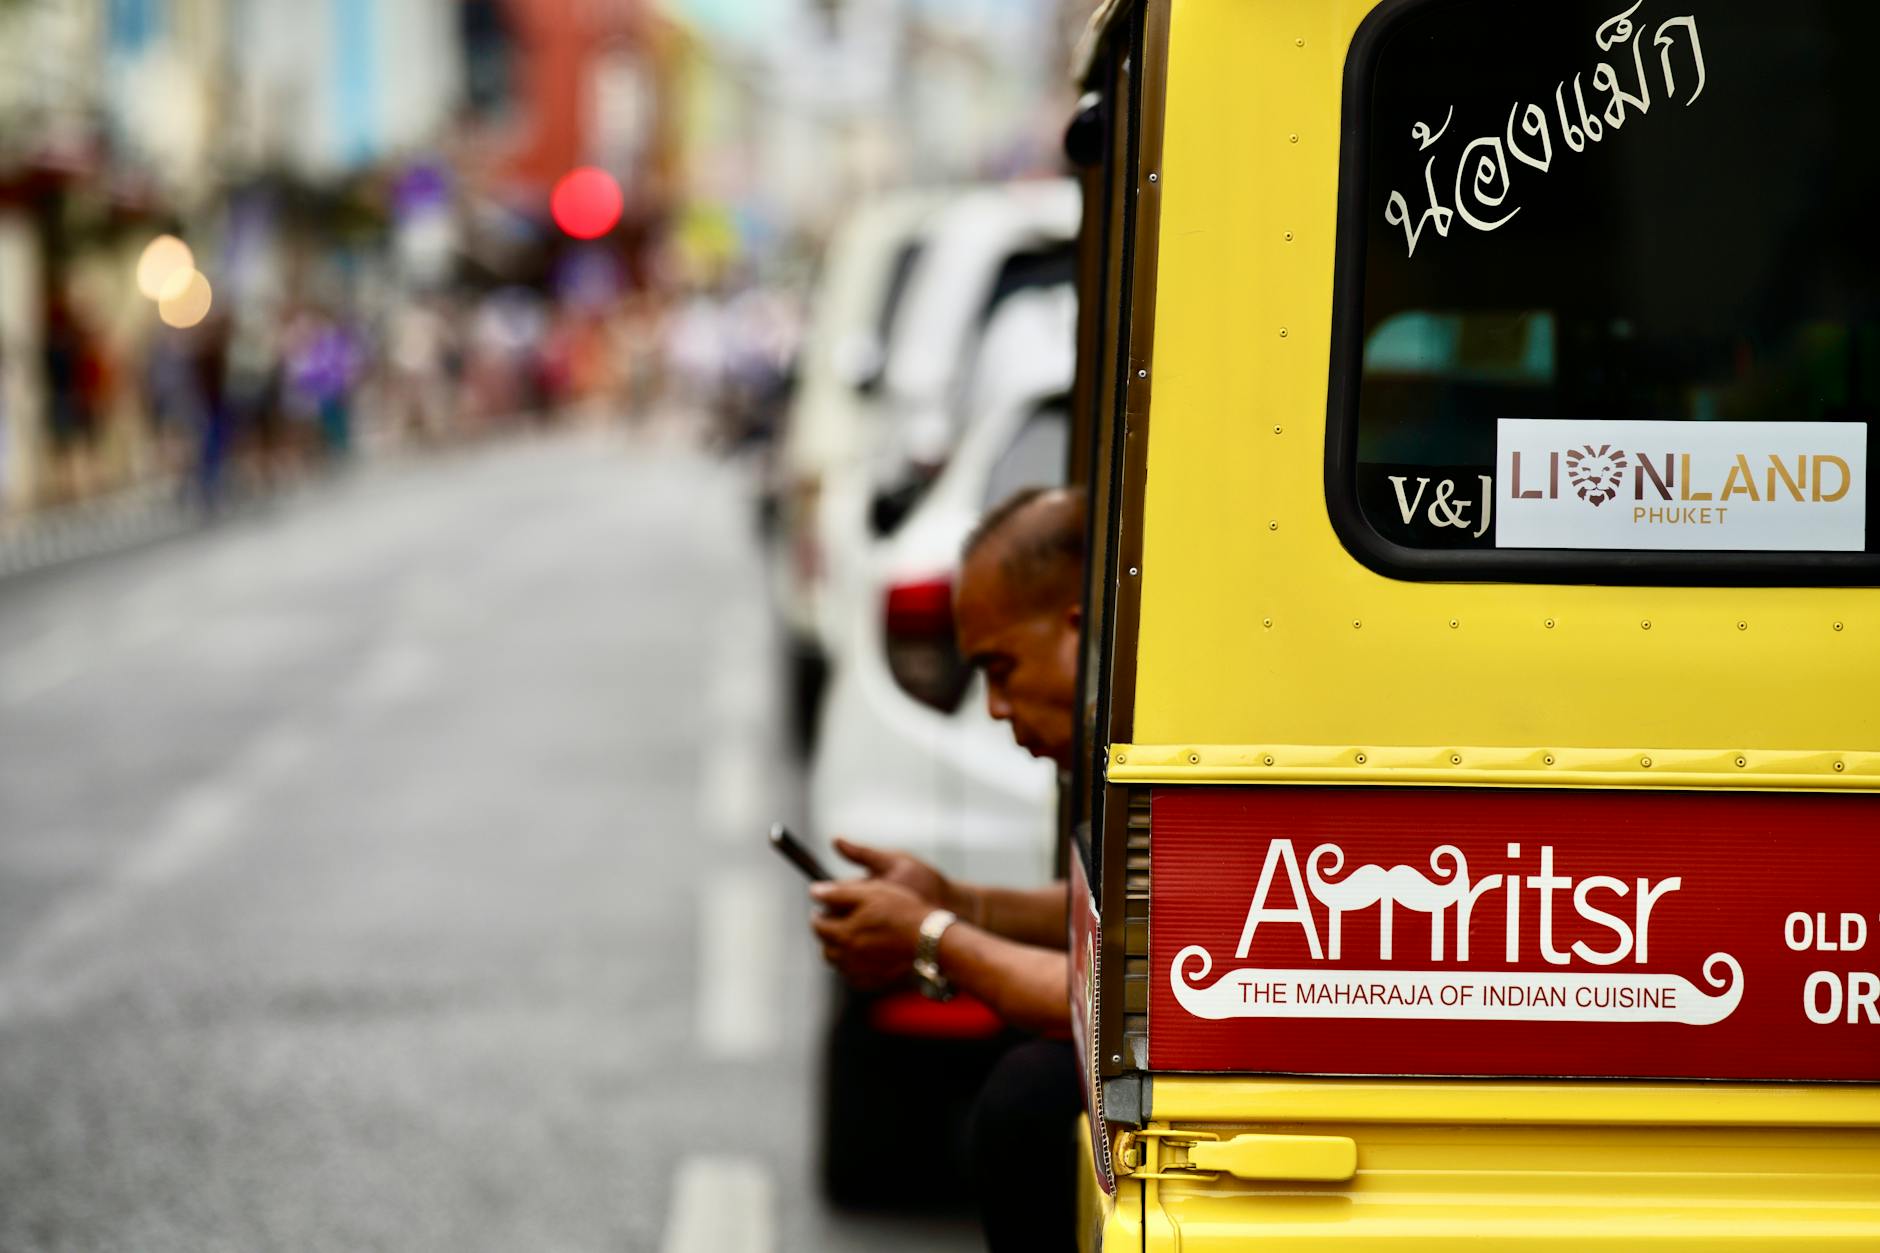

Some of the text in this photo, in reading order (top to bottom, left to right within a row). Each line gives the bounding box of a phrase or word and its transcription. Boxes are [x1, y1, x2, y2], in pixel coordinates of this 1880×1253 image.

[1388, 475, 1492, 538] V&J
[1633, 507, 1728, 524] PHUKET
[1234, 838, 1682, 966] Amritsr
[1784, 911, 1868, 951] OLD
[1238, 982, 1677, 1009] THE MAHARAJA OF INDIAN CUISINE
[1803, 970, 1880, 1025] OR
